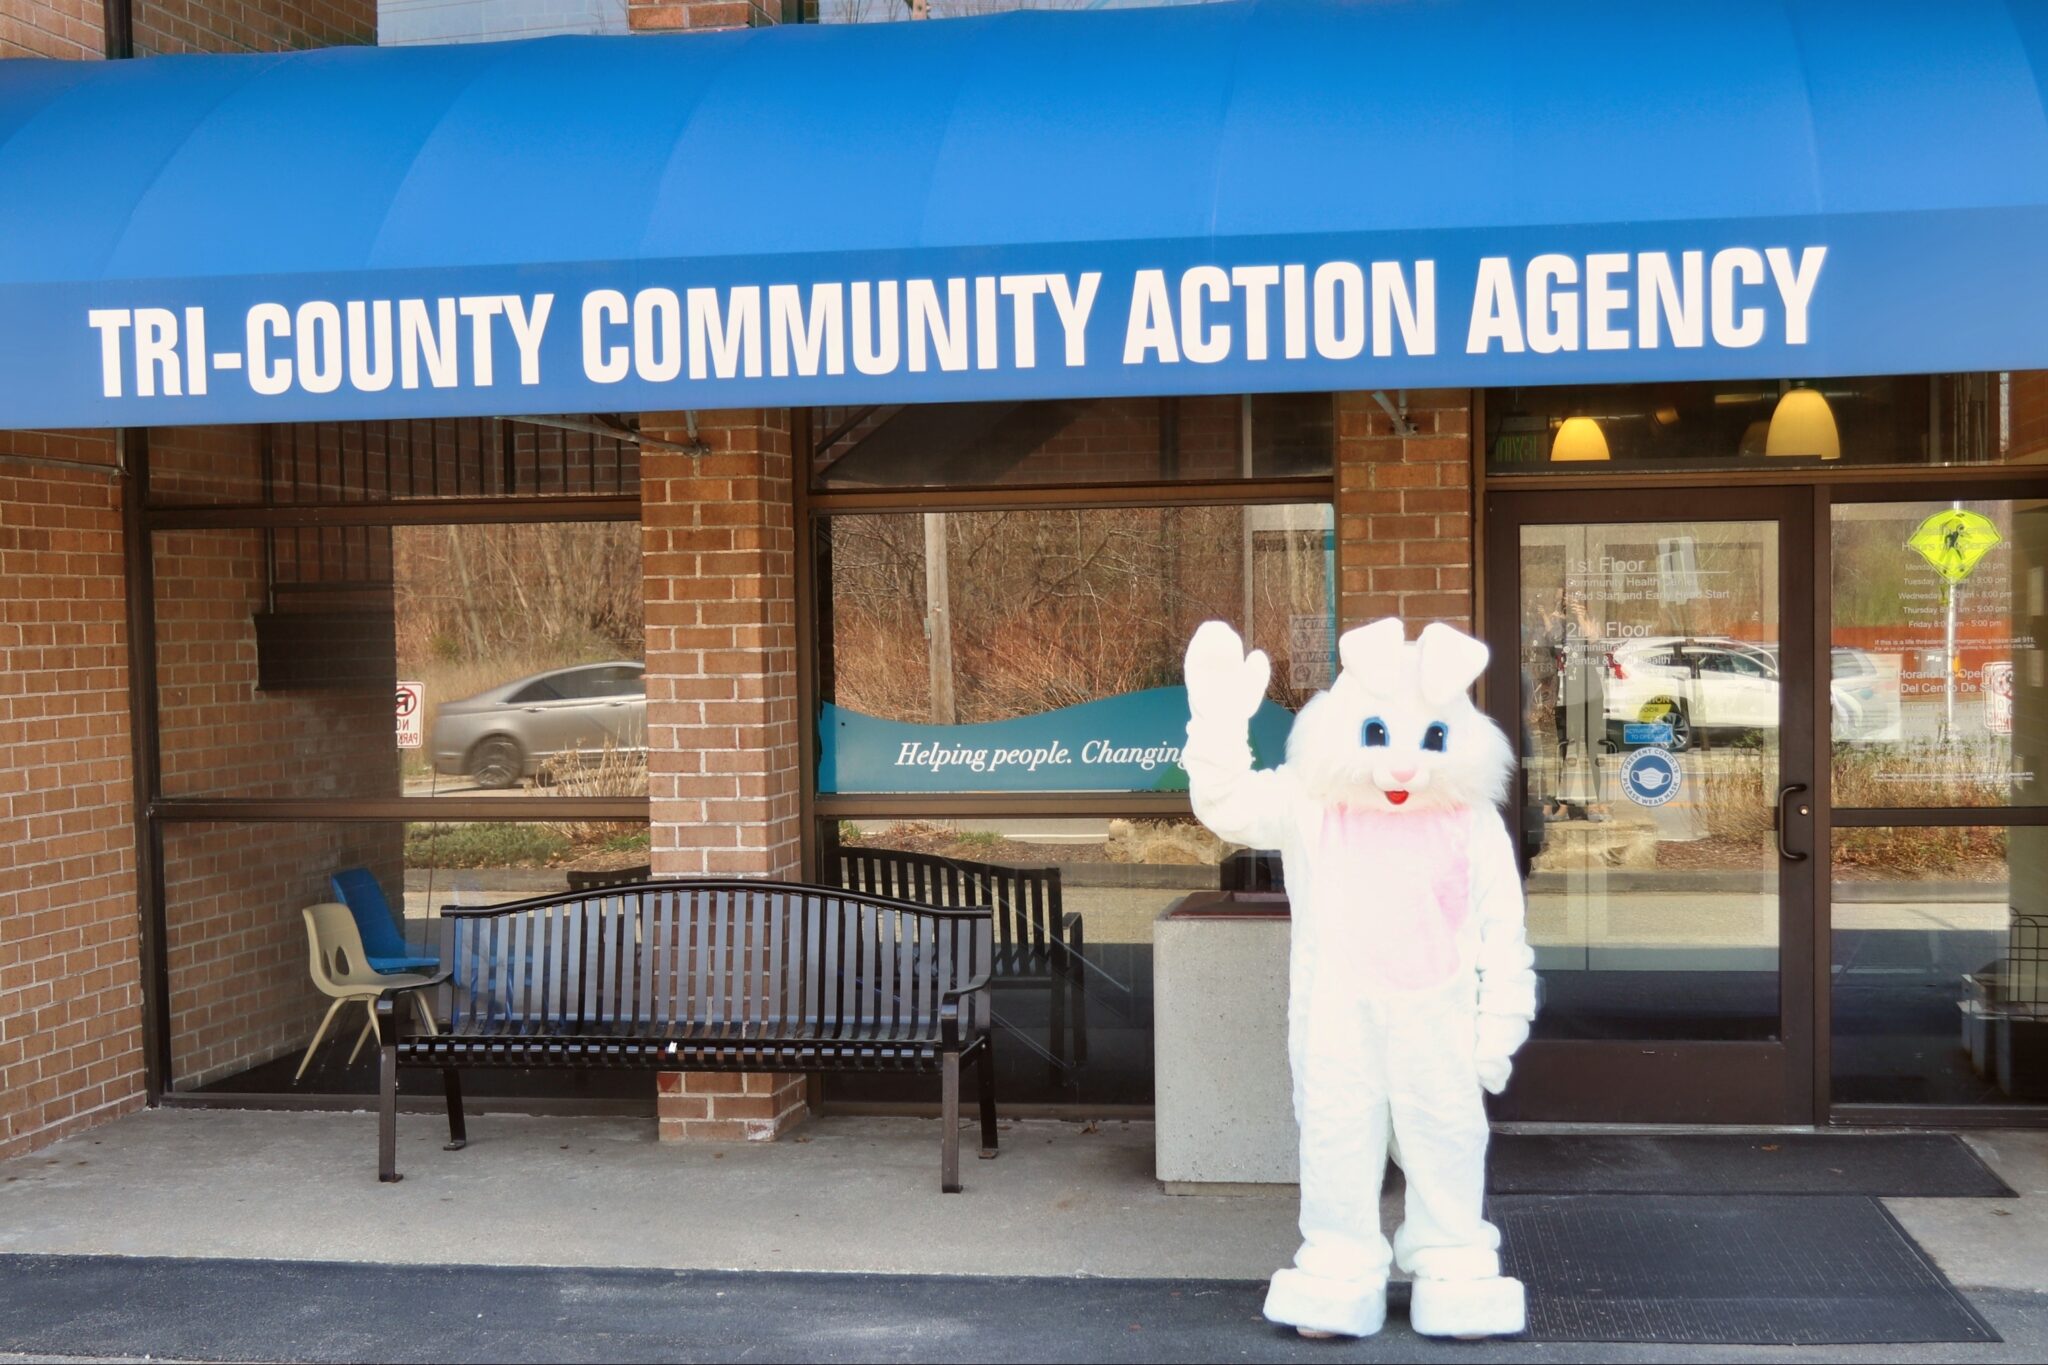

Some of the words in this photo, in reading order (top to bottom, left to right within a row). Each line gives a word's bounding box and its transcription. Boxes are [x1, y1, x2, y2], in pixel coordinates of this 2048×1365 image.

[89, 294, 553, 397] TRI-COUNTY
[583, 273, 1101, 383] COMMUNITY
[1123, 258, 1435, 363] ACTION
[1467, 247, 1826, 353] AGENCY
[1567, 558, 1592, 573] 1st
[1600, 557, 1646, 573] Floor
[1626, 576, 1659, 587] Health
[1904, 577, 1935, 586] Tuesday
[1995, 577, 2007, 585] pm
[1624, 591, 1642, 600] and
[1705, 589, 1730, 599] Start
[1898, 591, 1942, 601] Wednesday
[1903, 605, 1938, 614] Thursday
[1606, 621, 1652, 637] Floor
[1908, 620, 1931, 628] Friday
[1566, 655, 1599, 665] Dental
[1901, 683, 1919, 693] Del
[1961, 682, 1976, 692] De
[895, 741, 986, 772] Helping
[990, 740, 1071, 771] people.
[1625, 748, 1652, 770] PREVENT
[1623, 777, 1641, 802] PLEASE
[1641, 797, 1664, 805] WEAR
[1664, 782, 1679, 800] MASK
